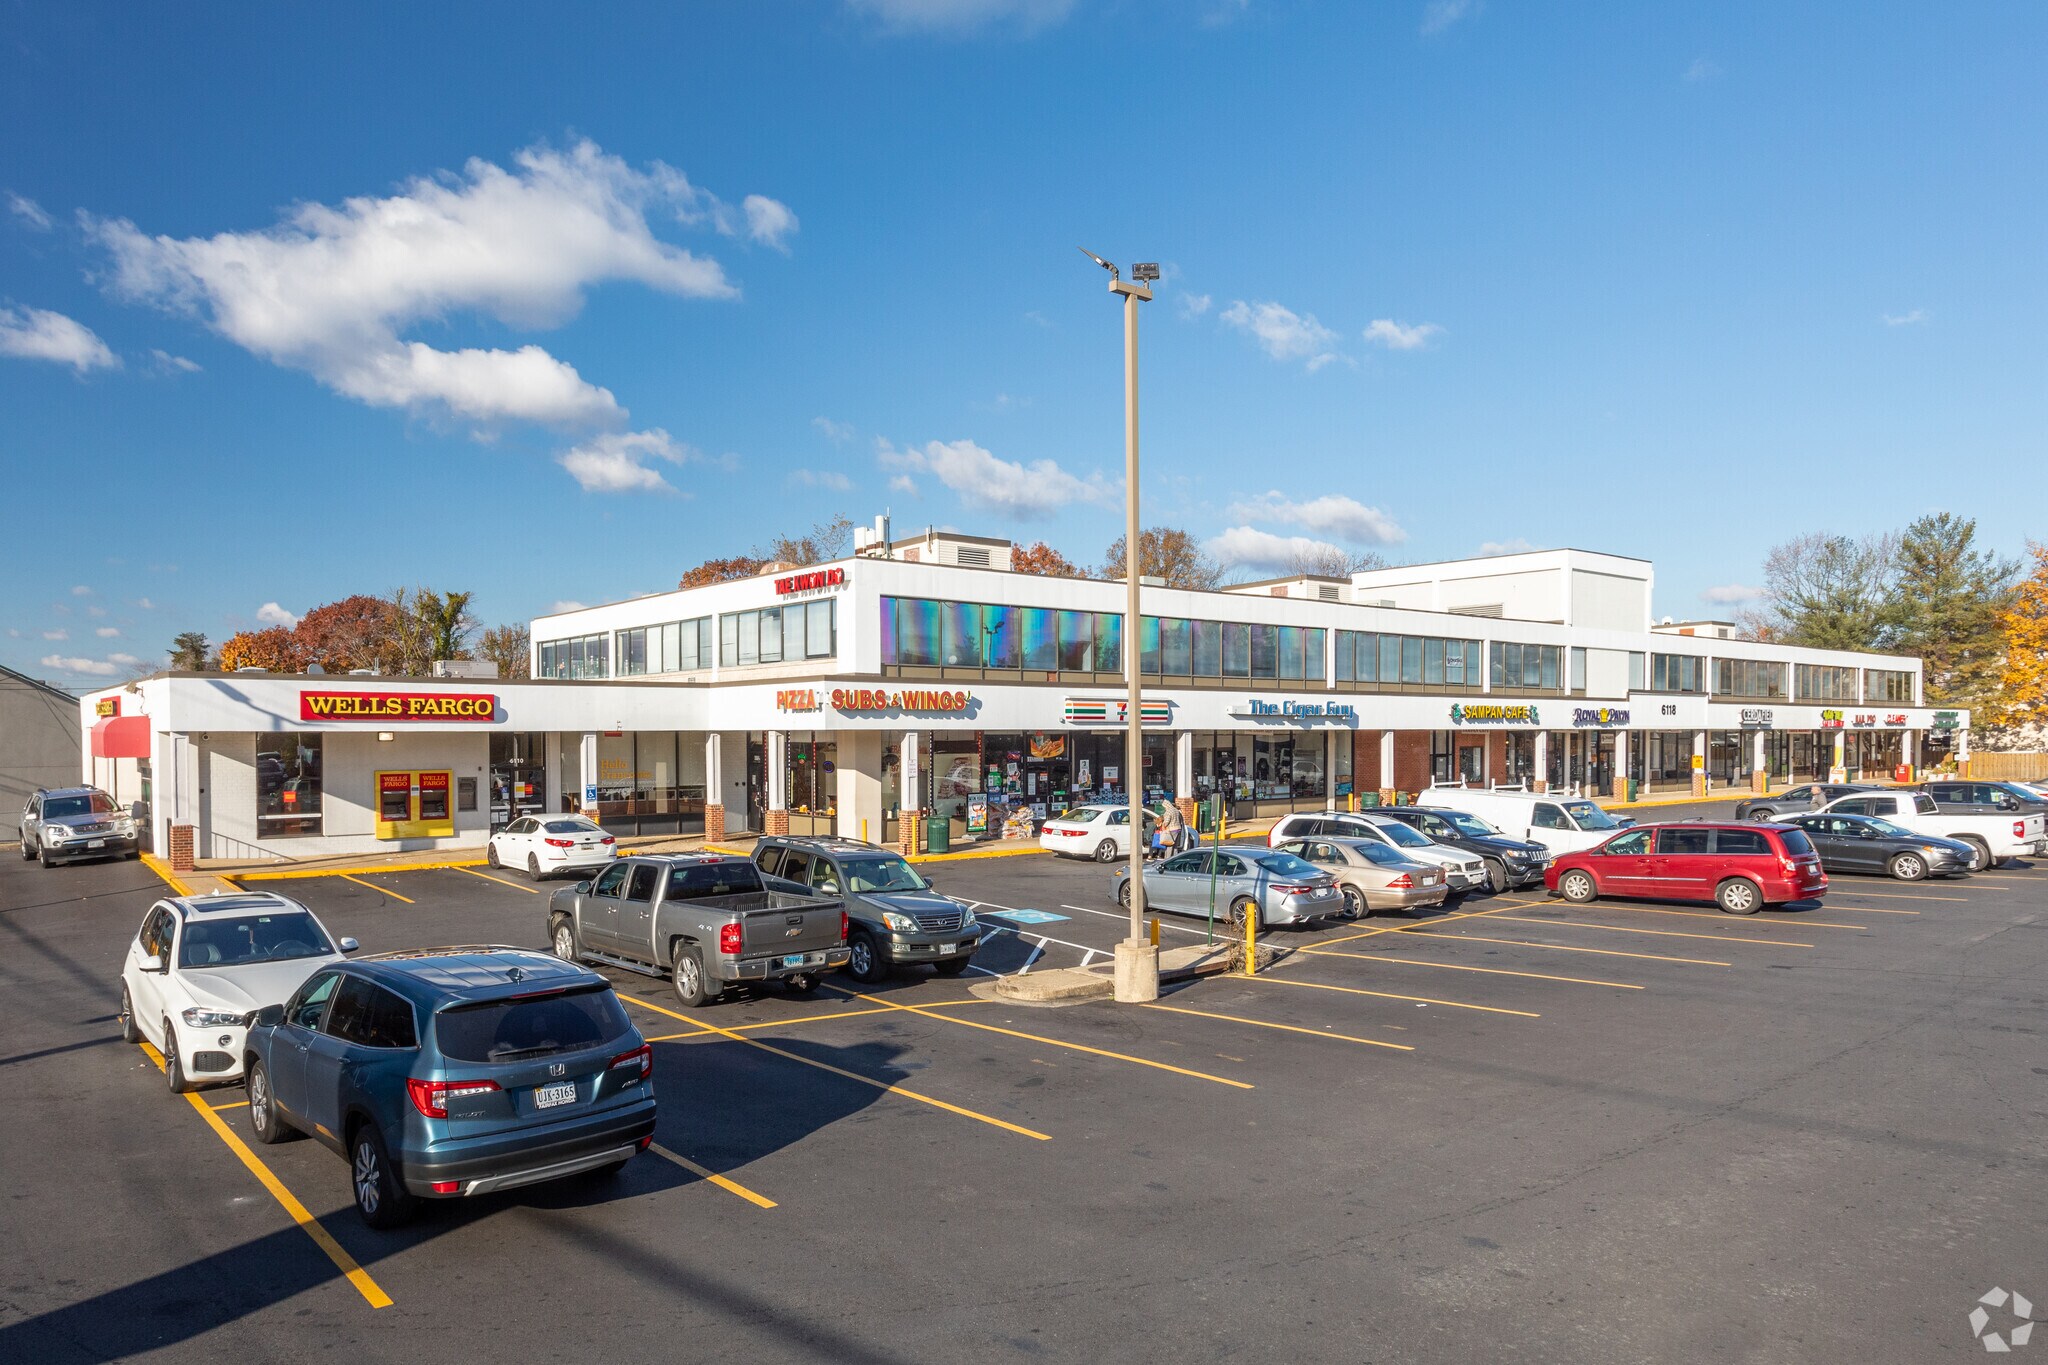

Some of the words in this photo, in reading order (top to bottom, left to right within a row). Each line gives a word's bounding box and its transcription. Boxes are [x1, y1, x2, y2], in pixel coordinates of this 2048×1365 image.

[774, 577, 791, 595] TAE
[794, 571, 825, 592] KWON
[827, 567, 843, 586] DO
[305, 696, 402, 715] WELLS
[407, 697, 492, 716] FARGO
[777, 689, 816, 709] PIZZA
[831, 688, 889, 710] SUBS
[1248, 699, 1279, 715] The
[1283, 700, 1322, 719] Cigar
[1326, 701, 1354, 719] Guy
[1464, 705, 1503, 719] SAMPAN
[1505, 705, 1529, 719] CAFE
[1661, 704, 1677, 716] 6118
[601, 757, 628, 769] Hello
[537, 1086, 575, 1103] UJK-3165
